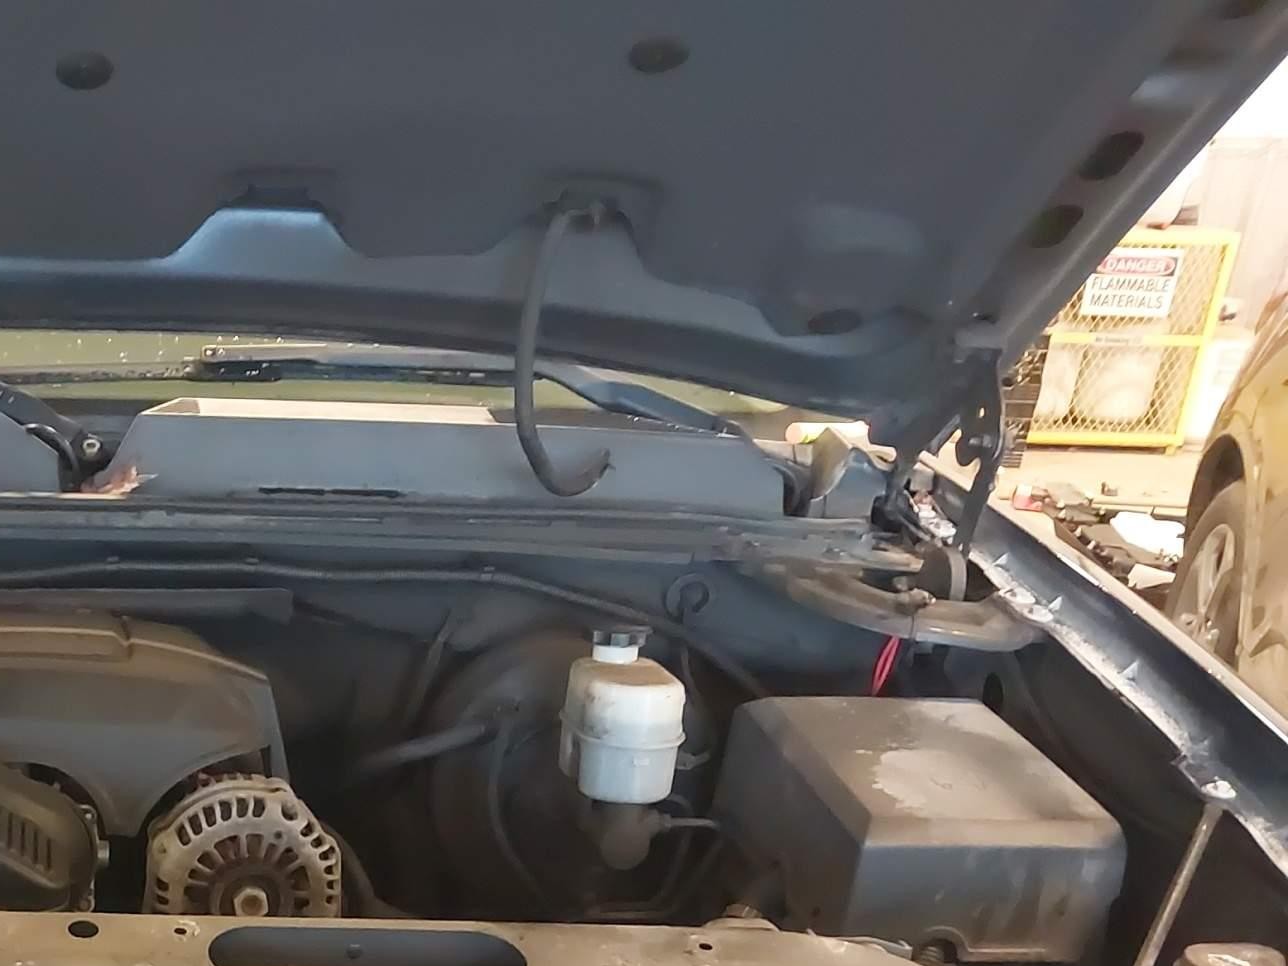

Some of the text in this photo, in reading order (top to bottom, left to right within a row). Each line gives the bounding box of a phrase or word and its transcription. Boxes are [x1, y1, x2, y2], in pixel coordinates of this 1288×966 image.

[1107, 257, 1167, 273] DANGER
[1091, 276, 1172, 293] FLAMMABLE
[1088, 293, 1164, 309] MATERIALS
